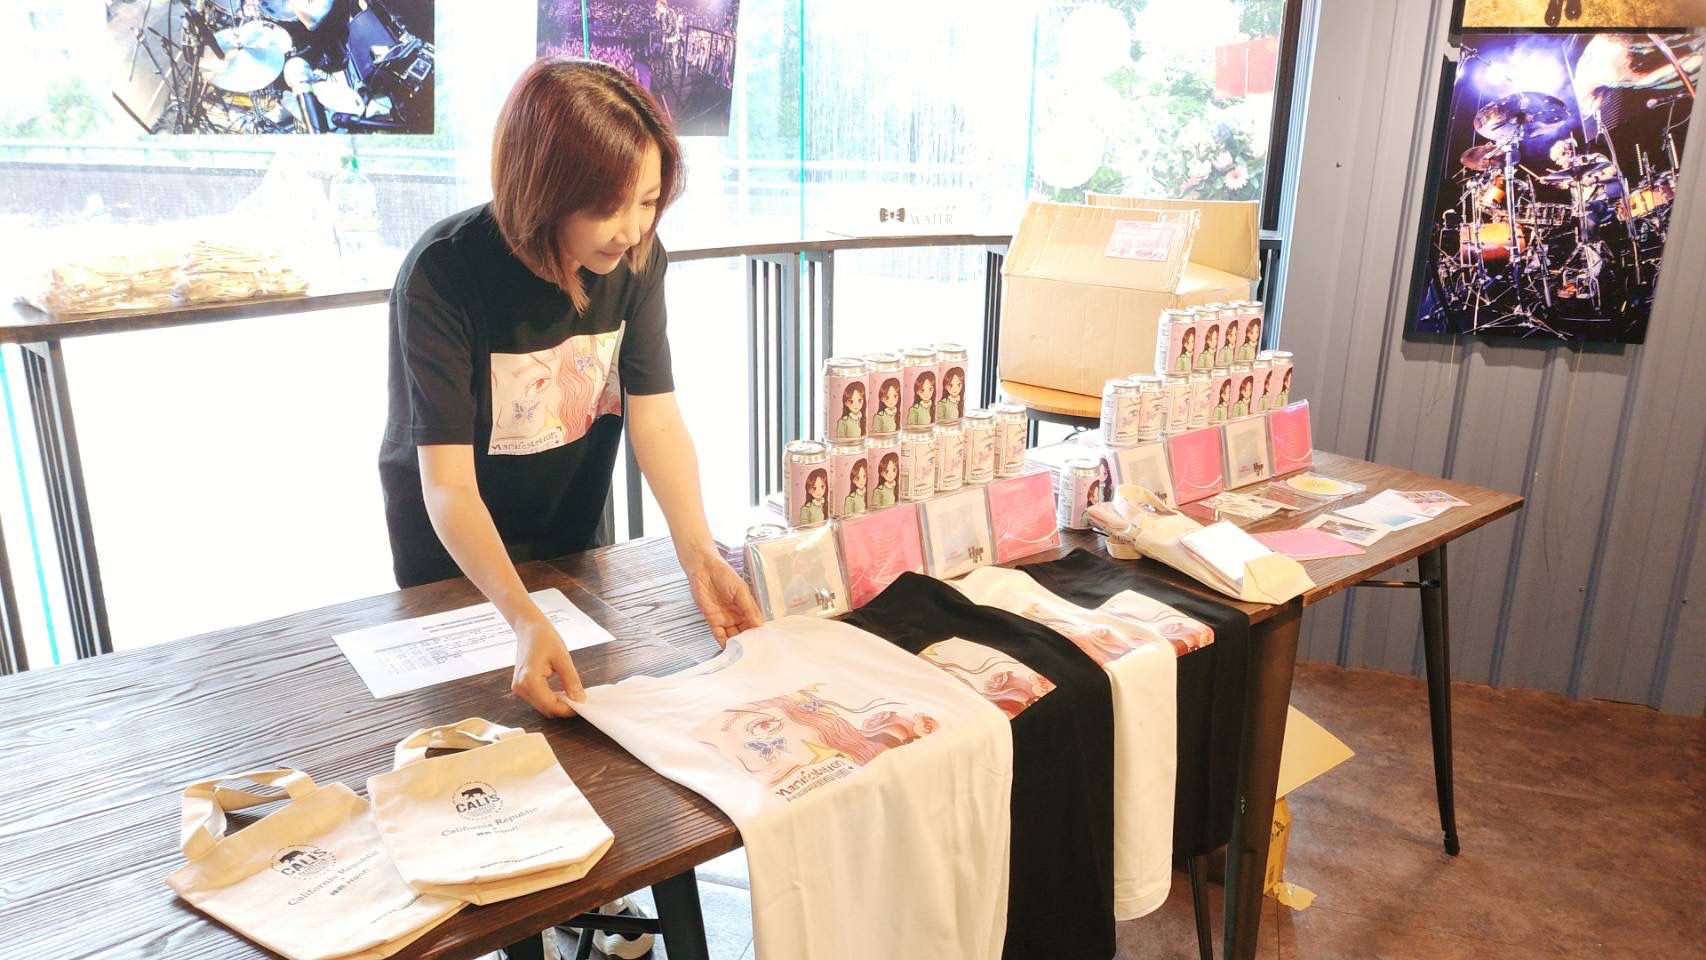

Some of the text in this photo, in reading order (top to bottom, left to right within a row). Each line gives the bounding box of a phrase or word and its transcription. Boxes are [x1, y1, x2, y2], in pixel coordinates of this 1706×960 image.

[455, 794, 501, 814] CALIS
[441, 822, 494, 837] California
[495, 806, 538, 826] Republic
[280, 848, 328, 877] CALIS
[287, 876, 338, 906] California
[337, 850, 381, 875] Republic
